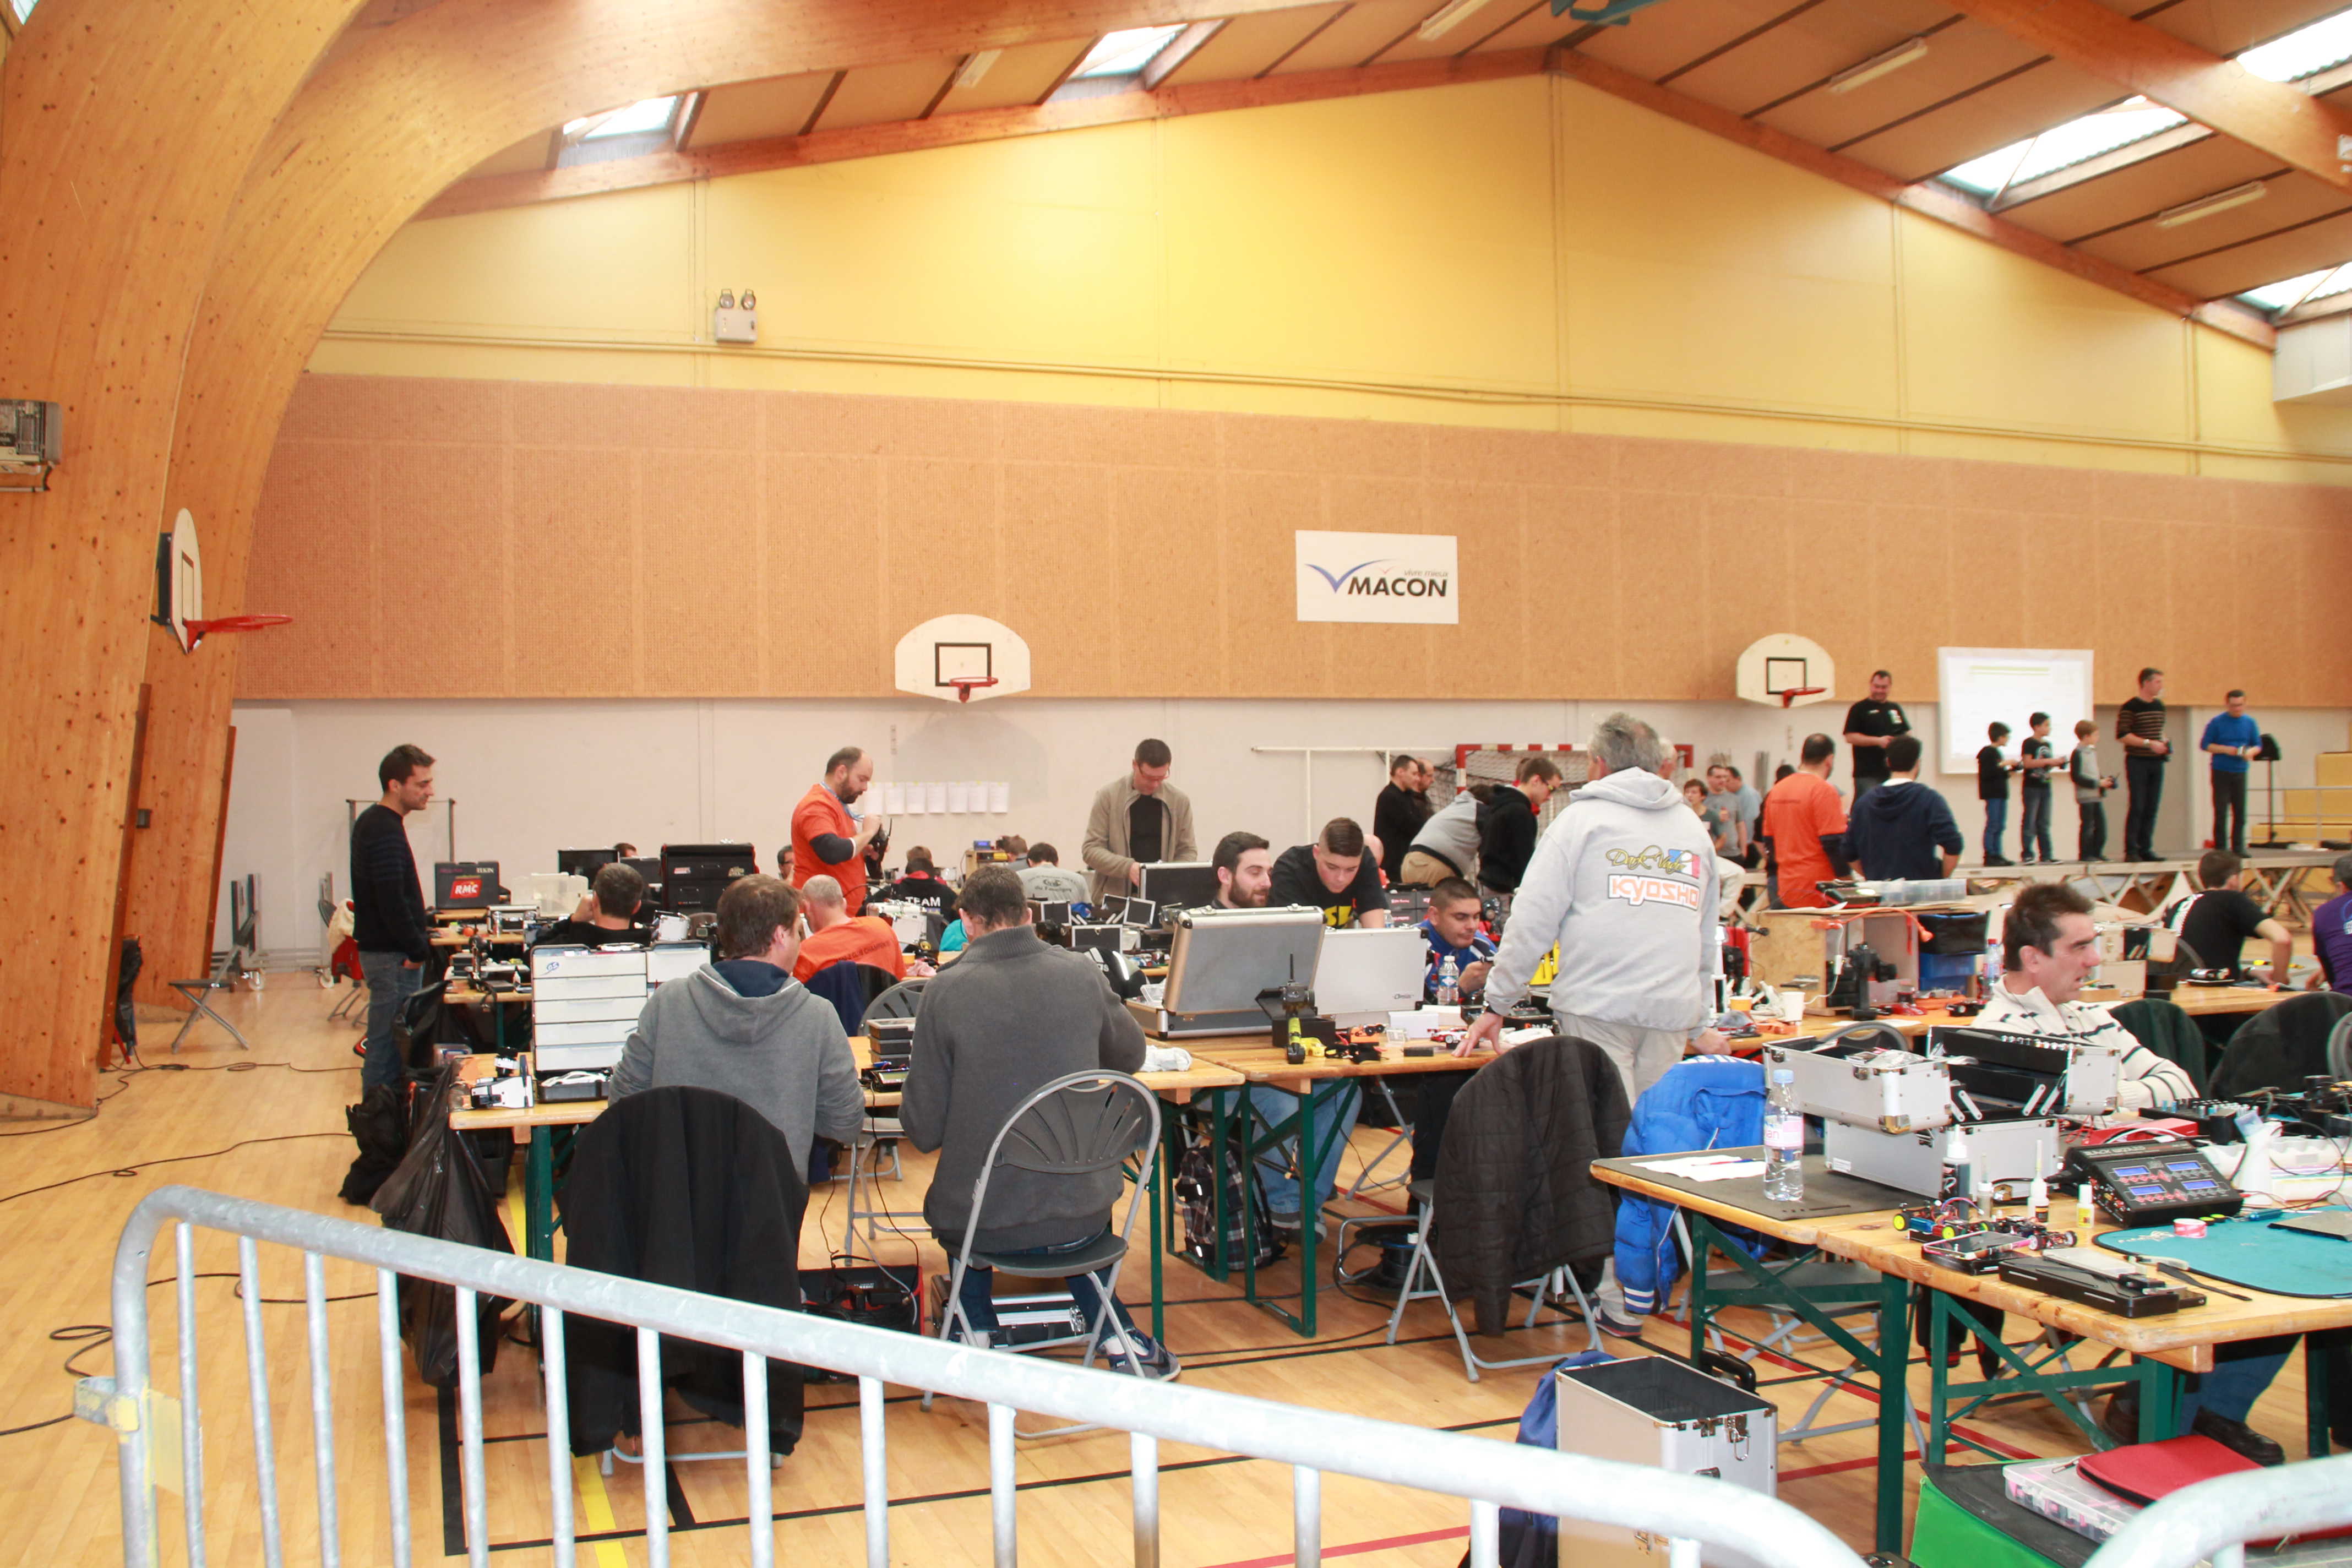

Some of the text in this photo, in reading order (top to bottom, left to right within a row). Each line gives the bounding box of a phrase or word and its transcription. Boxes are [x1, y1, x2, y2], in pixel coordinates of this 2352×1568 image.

[1403, 568, 1449, 577] vivre mieux
[1347, 576, 1447, 597] MACON
[1605, 845, 1657, 870] Dark
[454, 884, 478, 894] RMC
[1612, 878, 1700, 906] KYOSHO
[905, 896, 941, 907] TEAM
